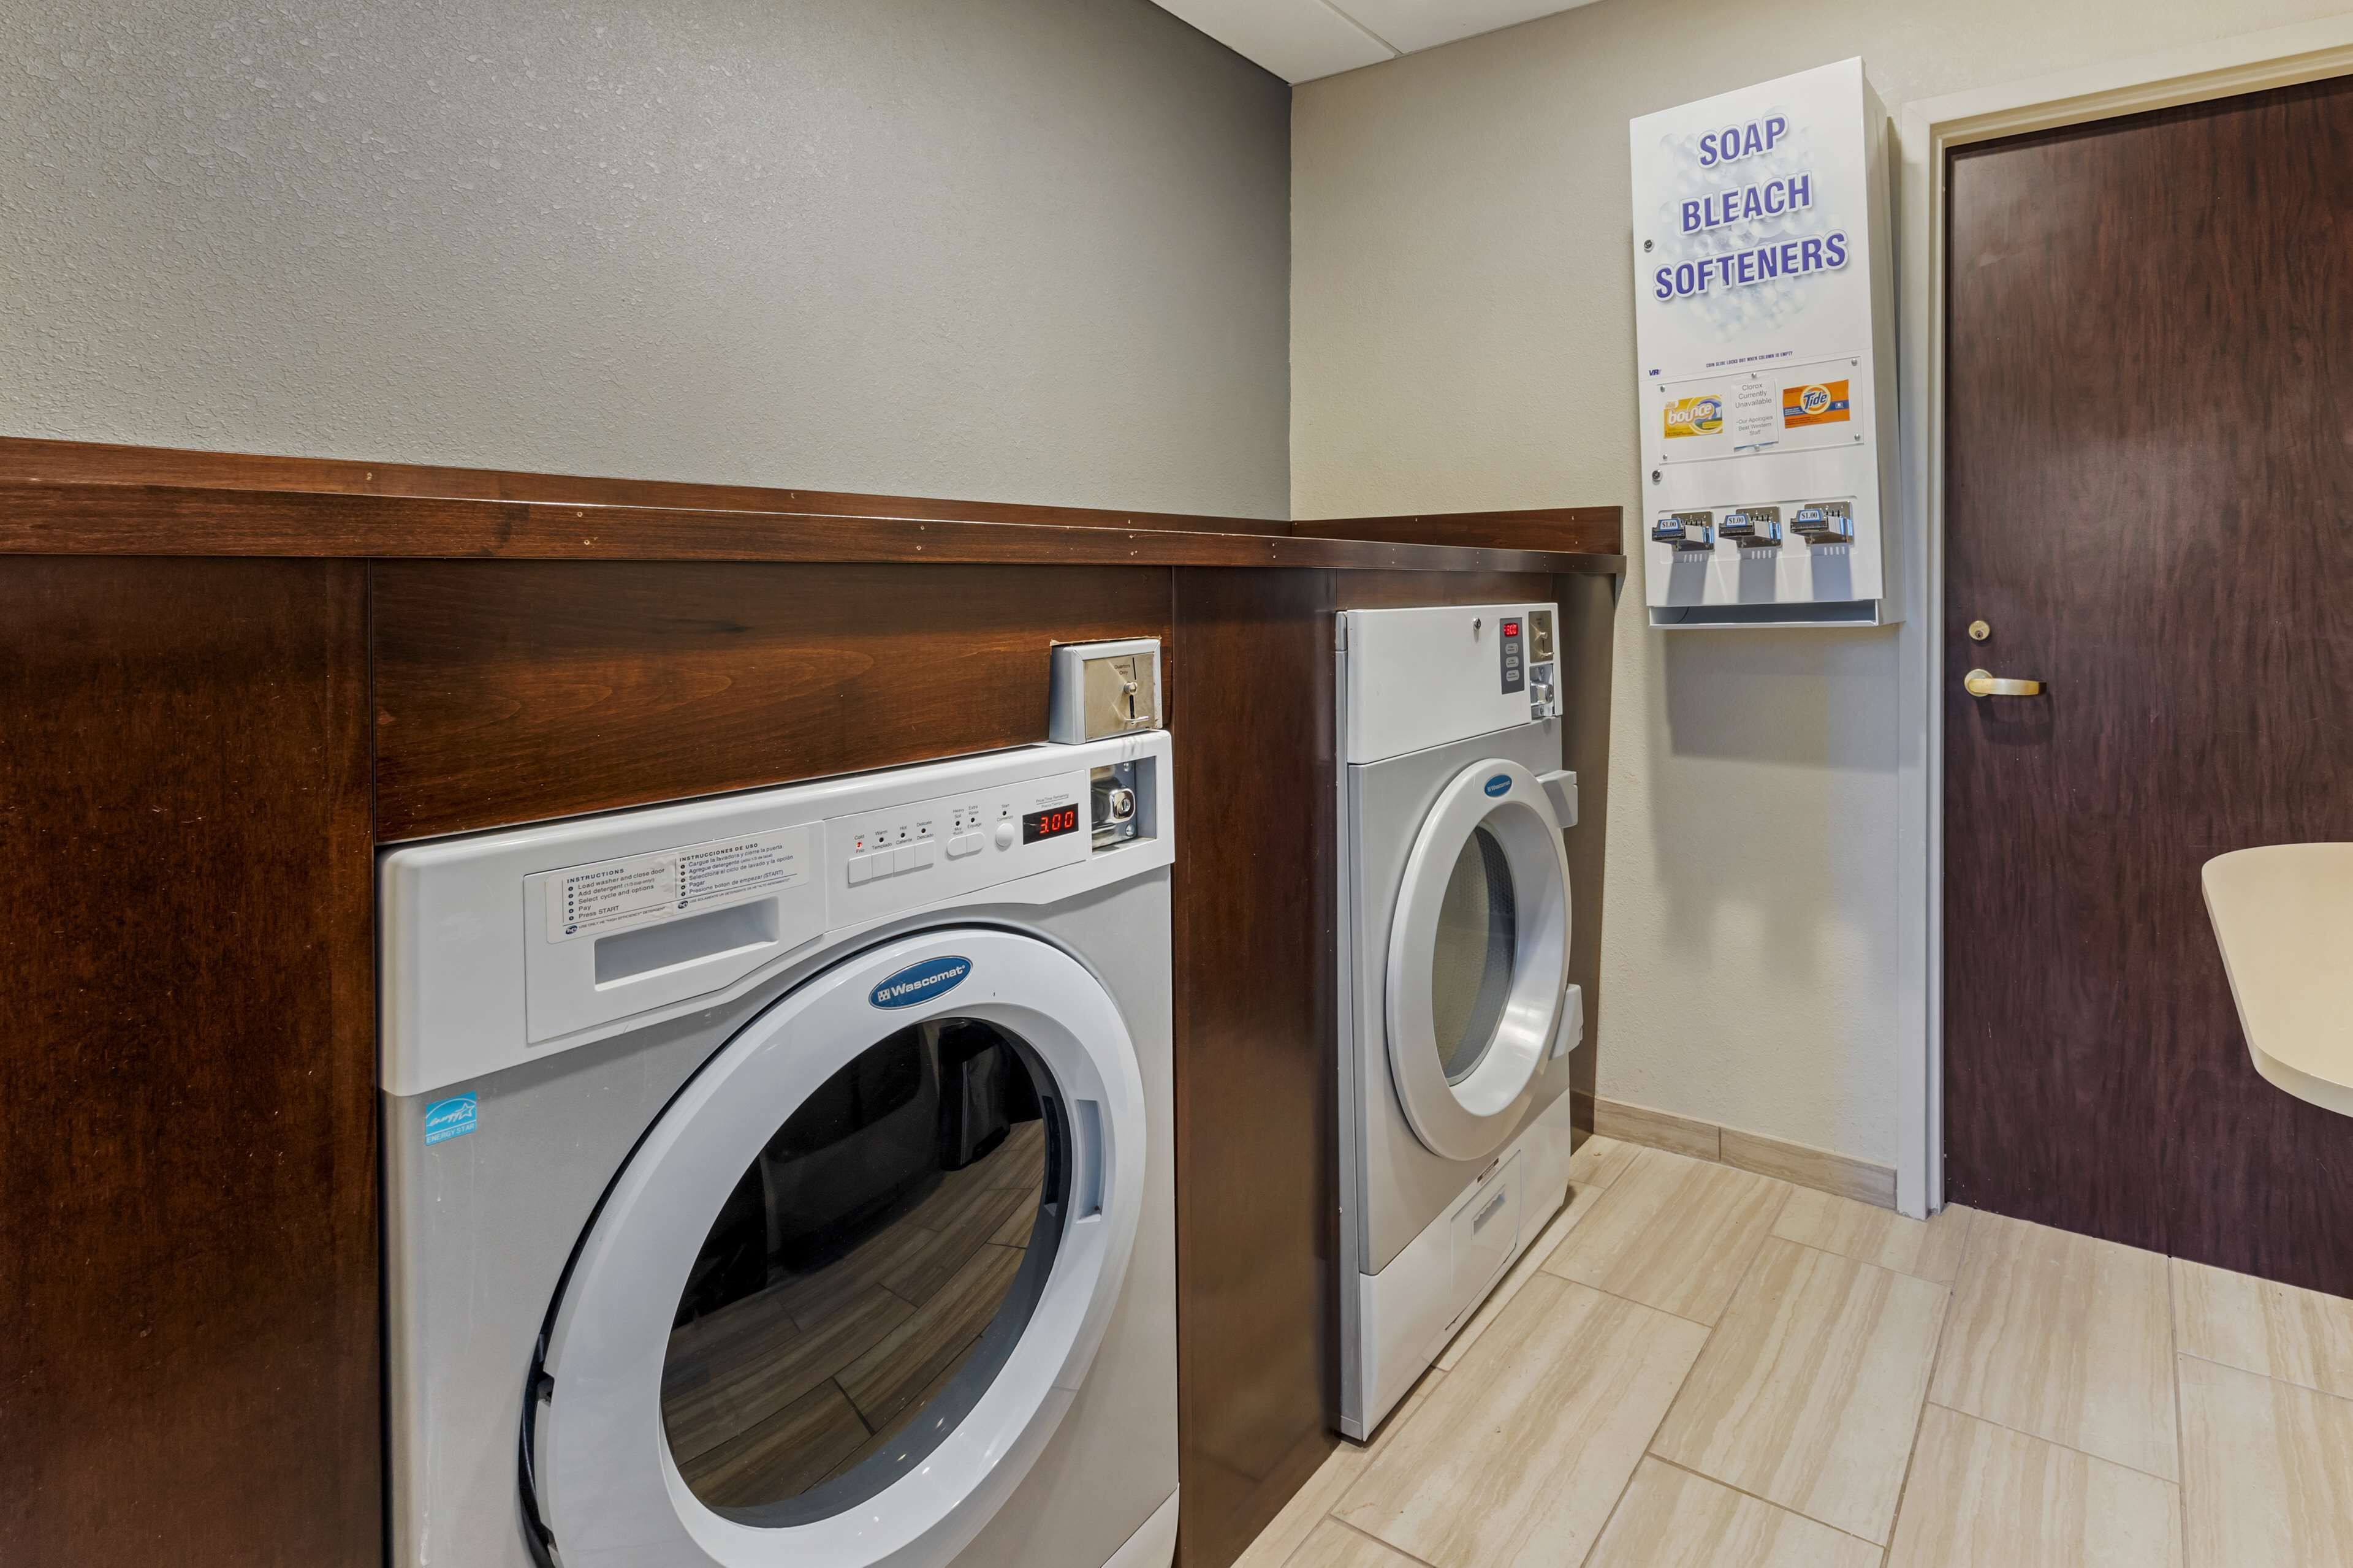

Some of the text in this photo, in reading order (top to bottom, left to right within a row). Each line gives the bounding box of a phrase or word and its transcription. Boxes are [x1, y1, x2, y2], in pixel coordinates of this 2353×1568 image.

[1700, 116, 1785, 166] SOAP
[1682, 173, 1810, 232] BLEACH
[1655, 233, 1846, 298] SOFTENERS
[1735, 398, 1773, 408] Unavailable
[1738, 390, 1768, 400] Currently
[1803, 392, 1828, 410] Tide
[1667, 403, 1713, 425] bounce
[1040, 811, 1074, 834] 3.00
[679, 848, 733, 862] INSTRUCCIONES
[712, 860, 740, 869] detergente
[567, 869, 624, 884] INSTRUCTIONS
[689, 871, 720, 881] Seleccione
[689, 885, 713, 894] Presione
[763, 869, 784, 879] (START)
[593, 884, 623, 894] detergent
[631, 885, 654, 893] options
[598, 906, 619, 915] START
[891, 966, 964, 997] Wascomat
[426, 1123, 474, 1144] ENERGY STAR
